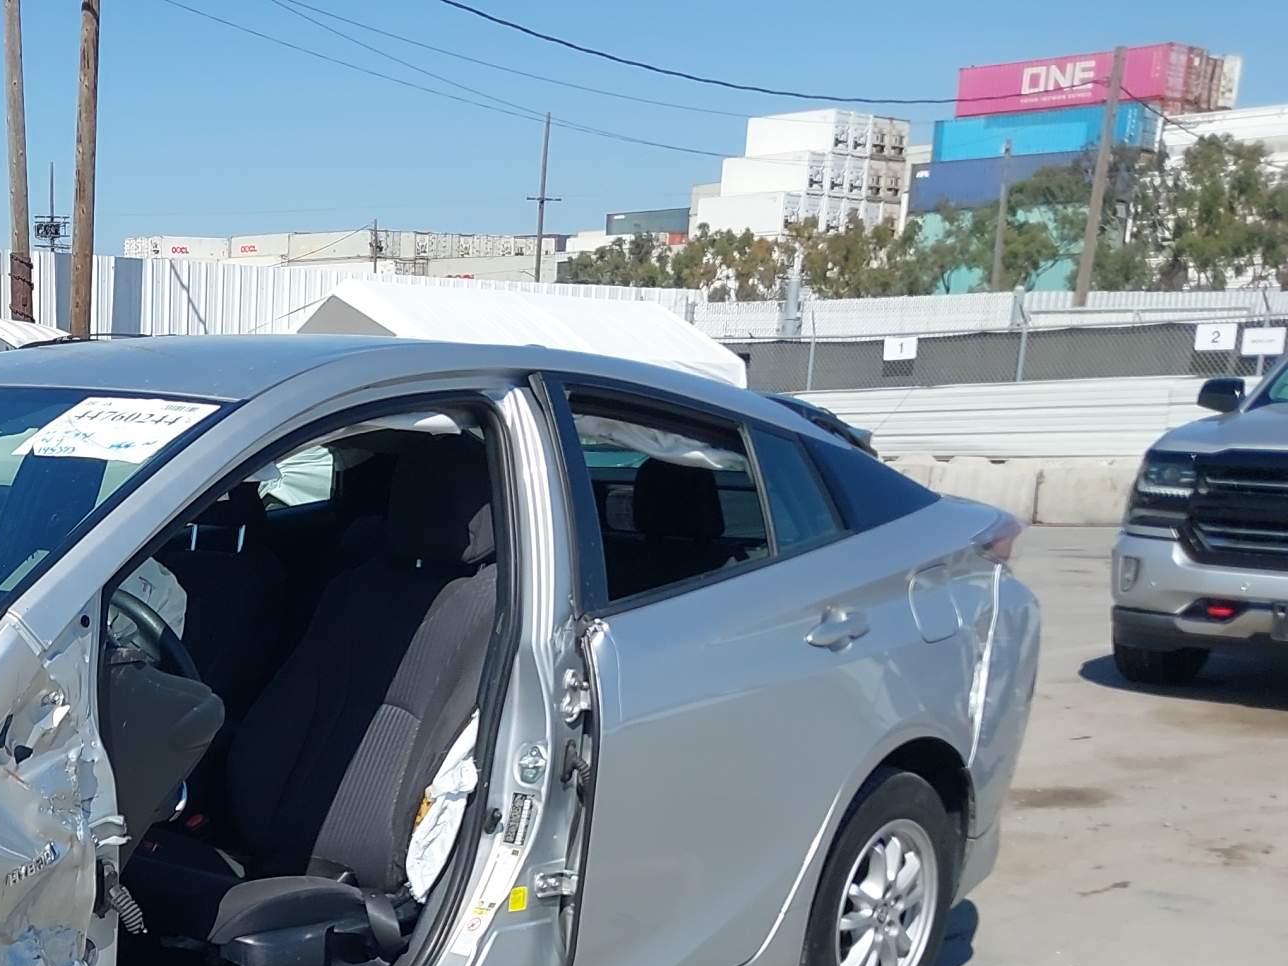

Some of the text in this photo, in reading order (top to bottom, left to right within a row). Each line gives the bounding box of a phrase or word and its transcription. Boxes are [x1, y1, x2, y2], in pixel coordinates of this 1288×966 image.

[1021, 60, 1096, 95] ONE
[171, 246, 189, 254] OOCL
[1210, 330, 1221, 344] 2
[74, 410, 184, 426] 44760244
